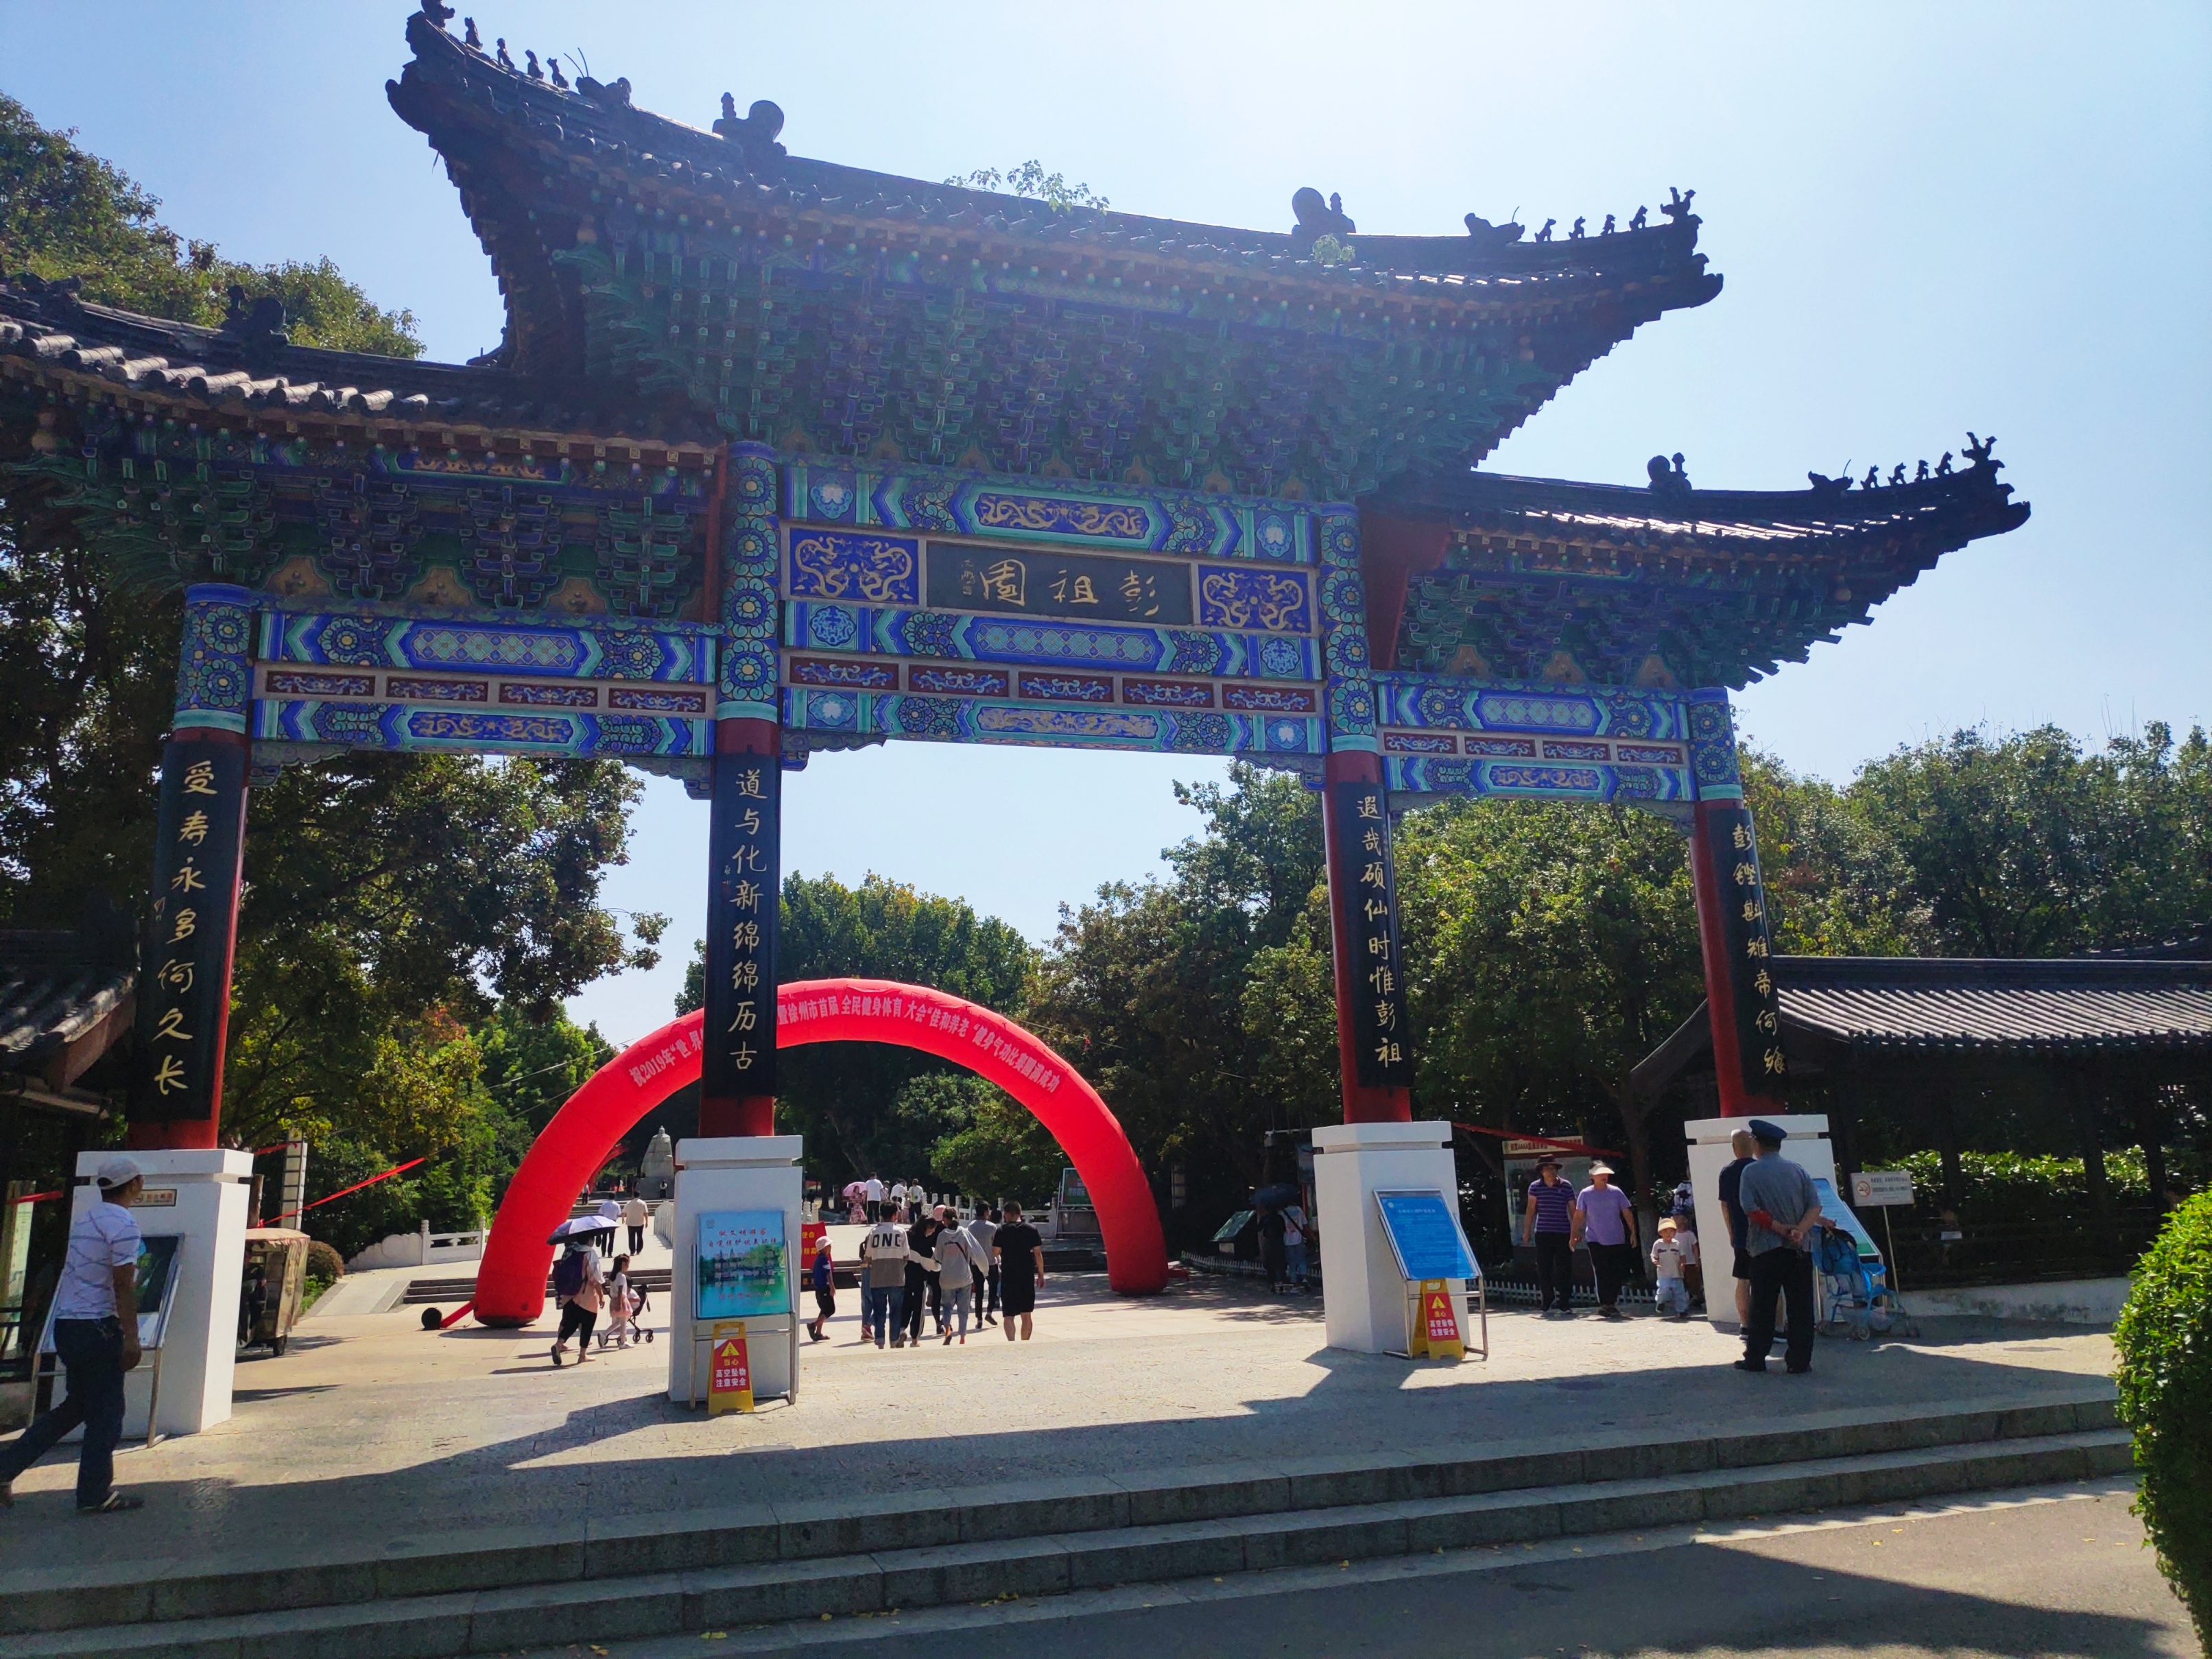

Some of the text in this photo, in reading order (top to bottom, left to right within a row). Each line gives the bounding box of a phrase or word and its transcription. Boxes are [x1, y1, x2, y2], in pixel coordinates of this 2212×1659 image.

[152, 760, 217, 1095] 受寿永多何久长
[728, 768, 768, 1071] 道与化新绵绵历古
[1357, 795, 1403, 1069] 遐哉硕仙时惟彭祖
[716, 1368, 746, 1378] 高空坠物
[716, 1377, 746, 1387] 注意安全
